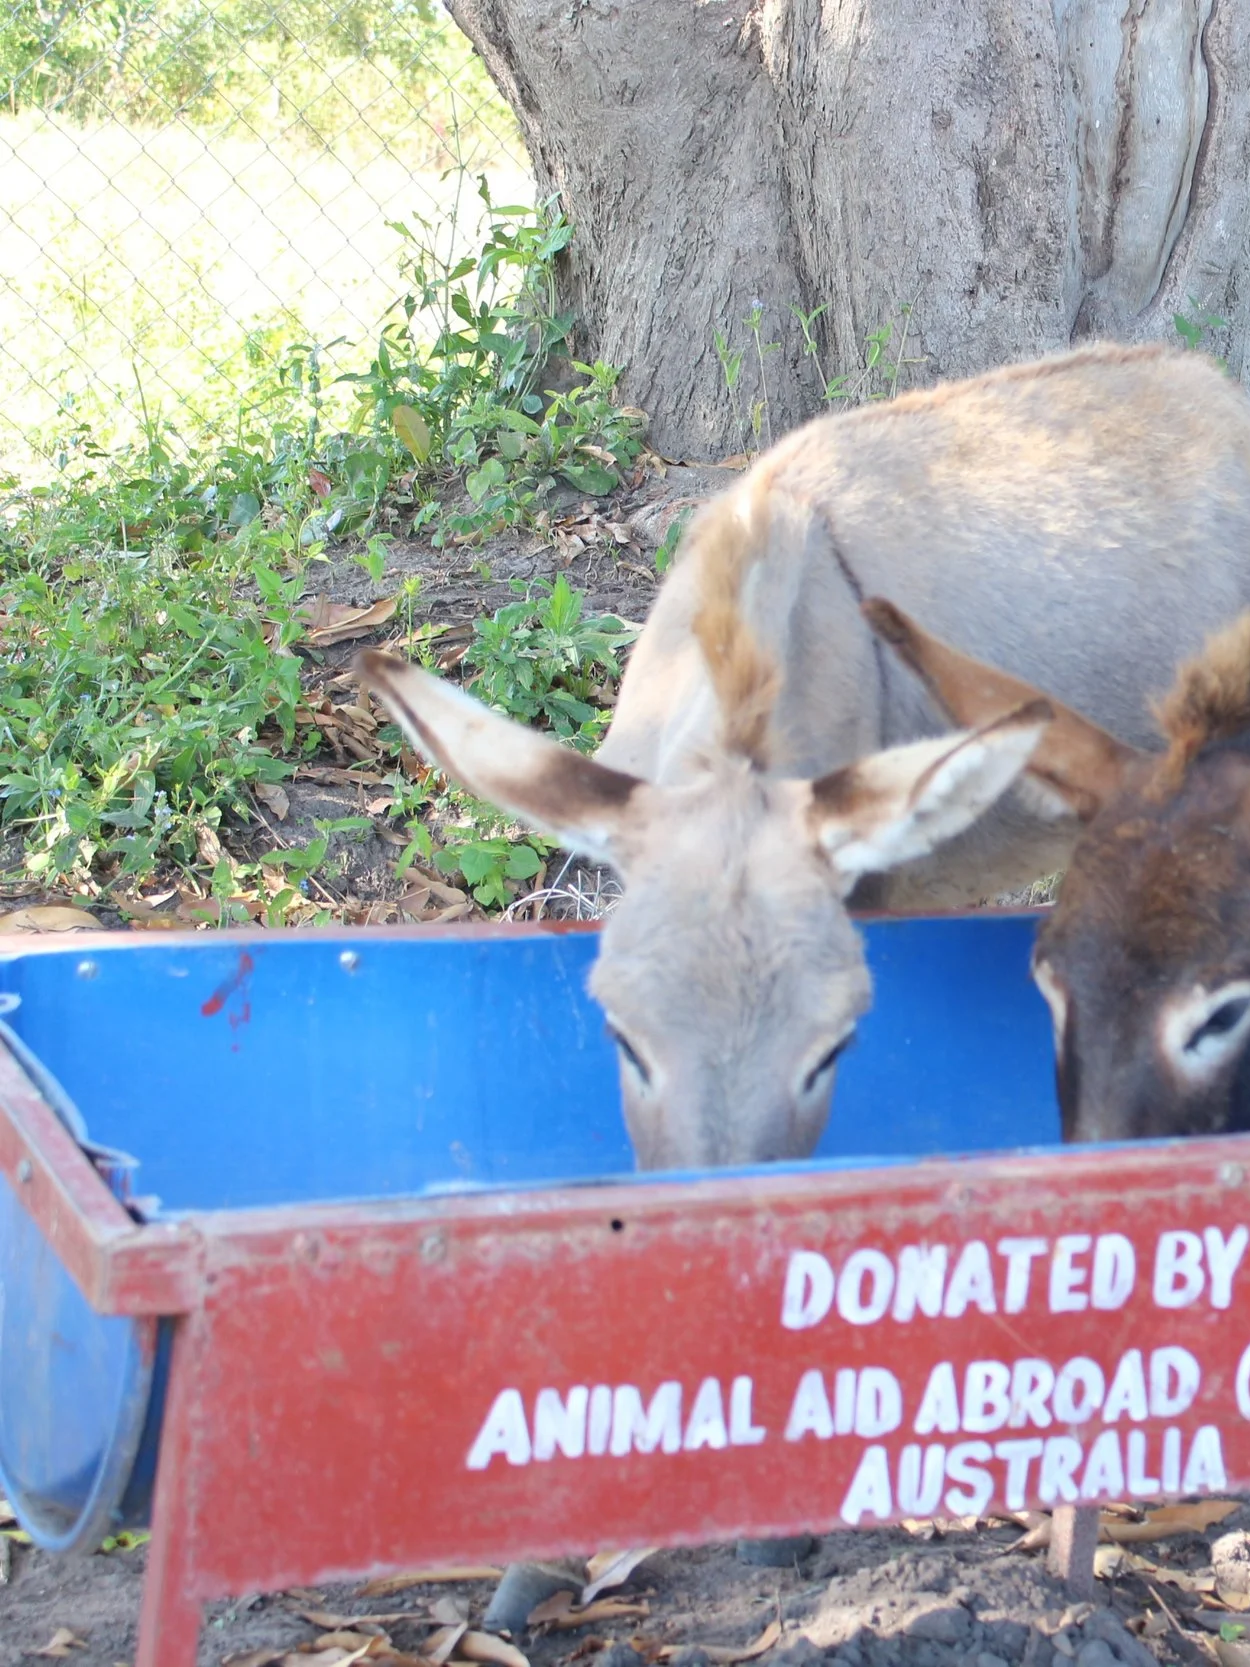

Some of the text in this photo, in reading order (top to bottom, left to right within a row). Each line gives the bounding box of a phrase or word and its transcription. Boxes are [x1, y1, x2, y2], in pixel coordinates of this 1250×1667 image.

[781, 1225, 1250, 1329] DONATED BY
[465, 1377, 766, 1470] ANIMAL
[785, 1367, 902, 1442] AID
[913, 1346, 1201, 1435] ABROAD
[840, 1425, 1229, 1527] AUSTRALIA
